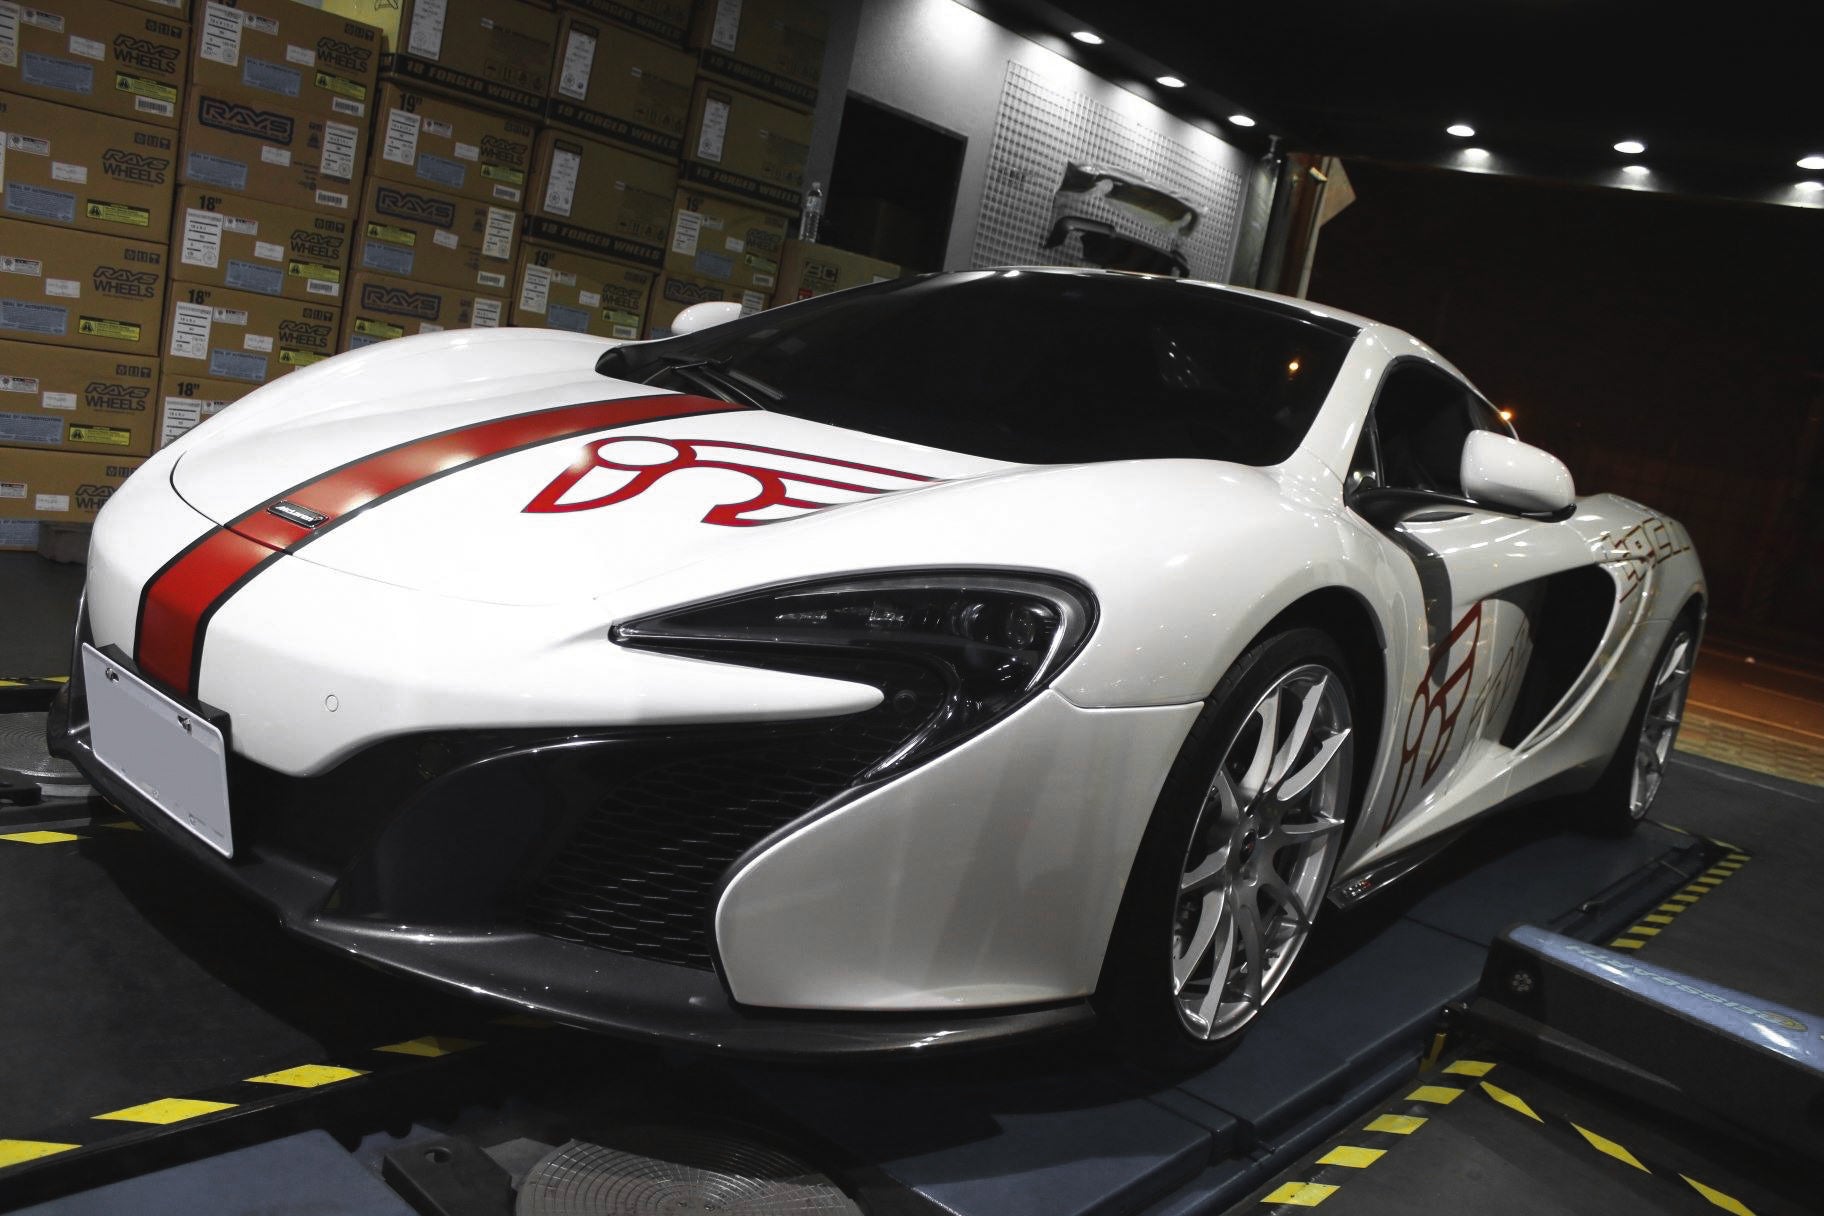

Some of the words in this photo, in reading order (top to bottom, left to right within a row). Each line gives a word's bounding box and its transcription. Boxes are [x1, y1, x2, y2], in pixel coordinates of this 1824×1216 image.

[113, 33, 181, 61] RAYS
[316, 36, 372, 61] RAYS
[114, 47, 176, 74] WHEELS
[317, 48, 368, 74] WHEELS
[429, 67, 484, 91] FORGED
[488, 83, 541, 108] WHEELS
[202, 99, 290, 136] RAYS
[481, 134, 529, 155] RAYS
[102, 148, 170, 171] RAYS
[481, 145, 525, 165] WHEELS
[102, 161, 165, 185] WHEELS
[199, 195, 222, 211] 18"
[379, 190, 453, 220] RAYS
[291, 229, 344, 248] RAYS
[560, 226, 611, 248] FORGED
[614, 239, 662, 259] WHEELS
[291, 241, 340, 260] WHEELS
[93, 265, 160, 285] RAYS
[93, 279, 154, 298] WHEELS
[188, 289, 211, 305] 18"
[364, 285, 438, 311] RAYS
[279, 320, 332, 336] RAYS
[279, 331, 328, 348] WHEELS
[85, 382, 150, 398] RAYS
[177, 382, 200, 396] 18"
[85, 394, 146, 412] WHEELS
